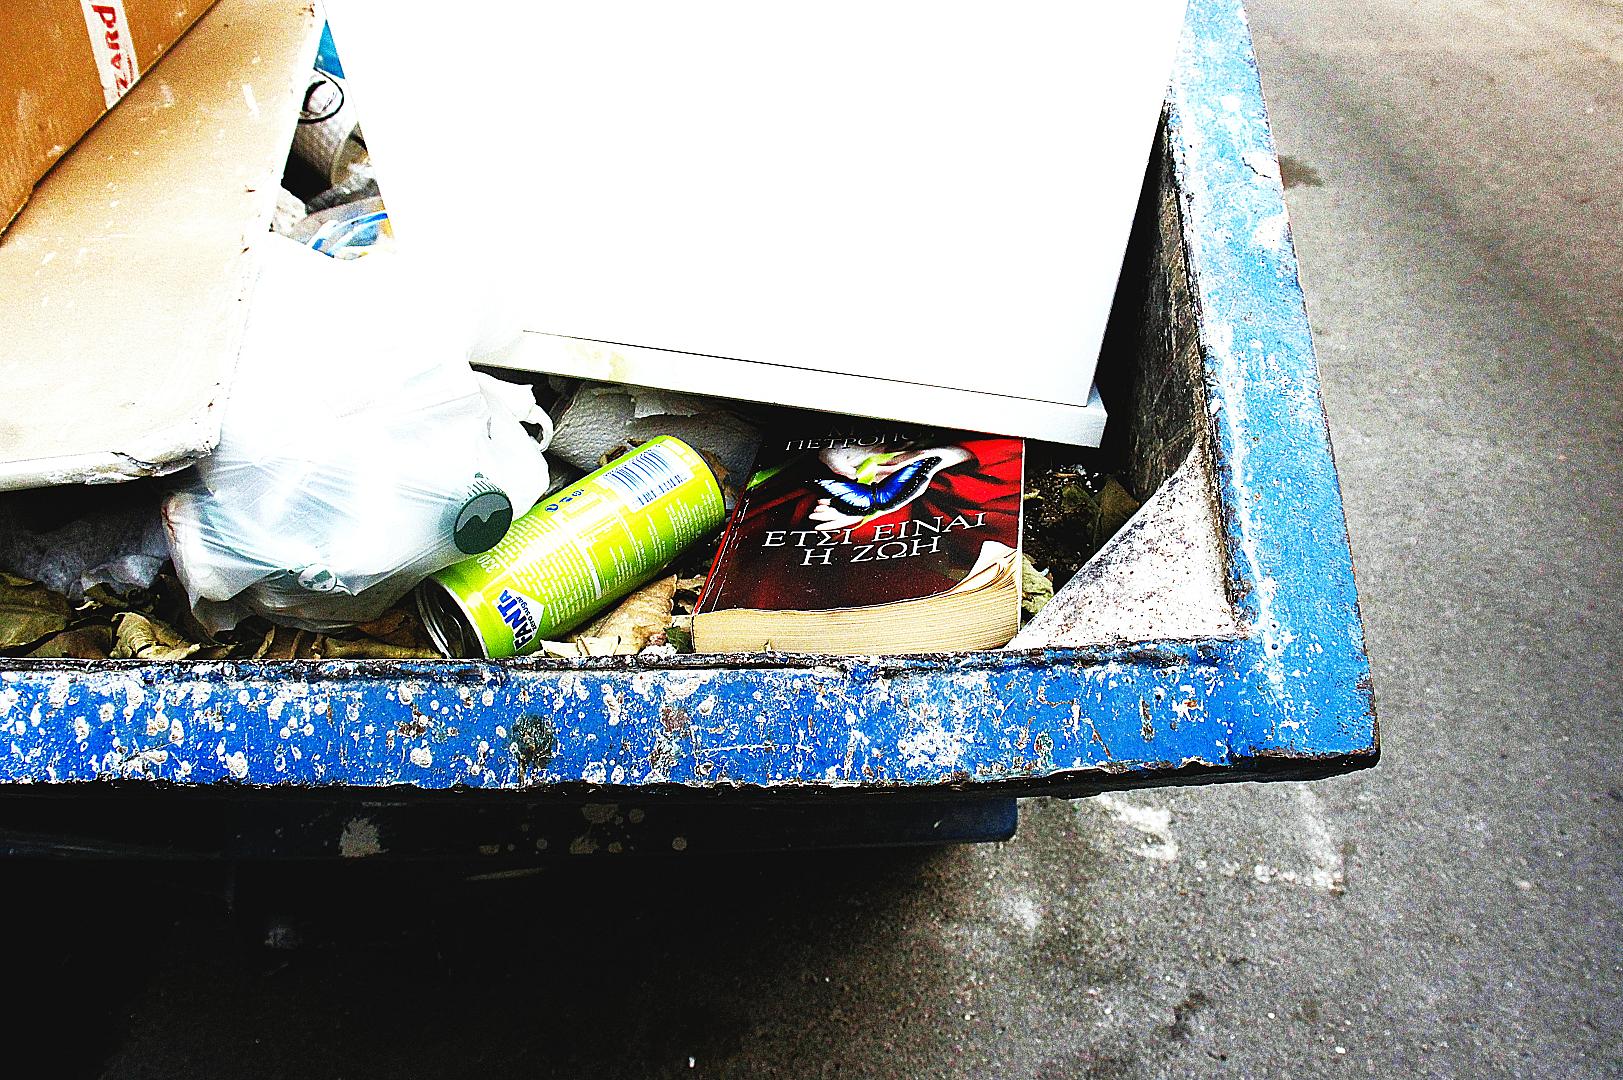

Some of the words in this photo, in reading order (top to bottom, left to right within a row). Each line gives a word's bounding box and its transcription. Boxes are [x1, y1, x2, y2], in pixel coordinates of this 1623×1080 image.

[762, 528, 856, 547] ΕΤΣΙ
[873, 512, 987, 542] ΕΙΝΑΙ
[799, 547, 832, 566] Η
[850, 535, 942, 564] ΖΩΗ
[497, 589, 534, 651] FANTA
[515, 596, 531, 616] sugar
[527, 615, 538, 631] zero
